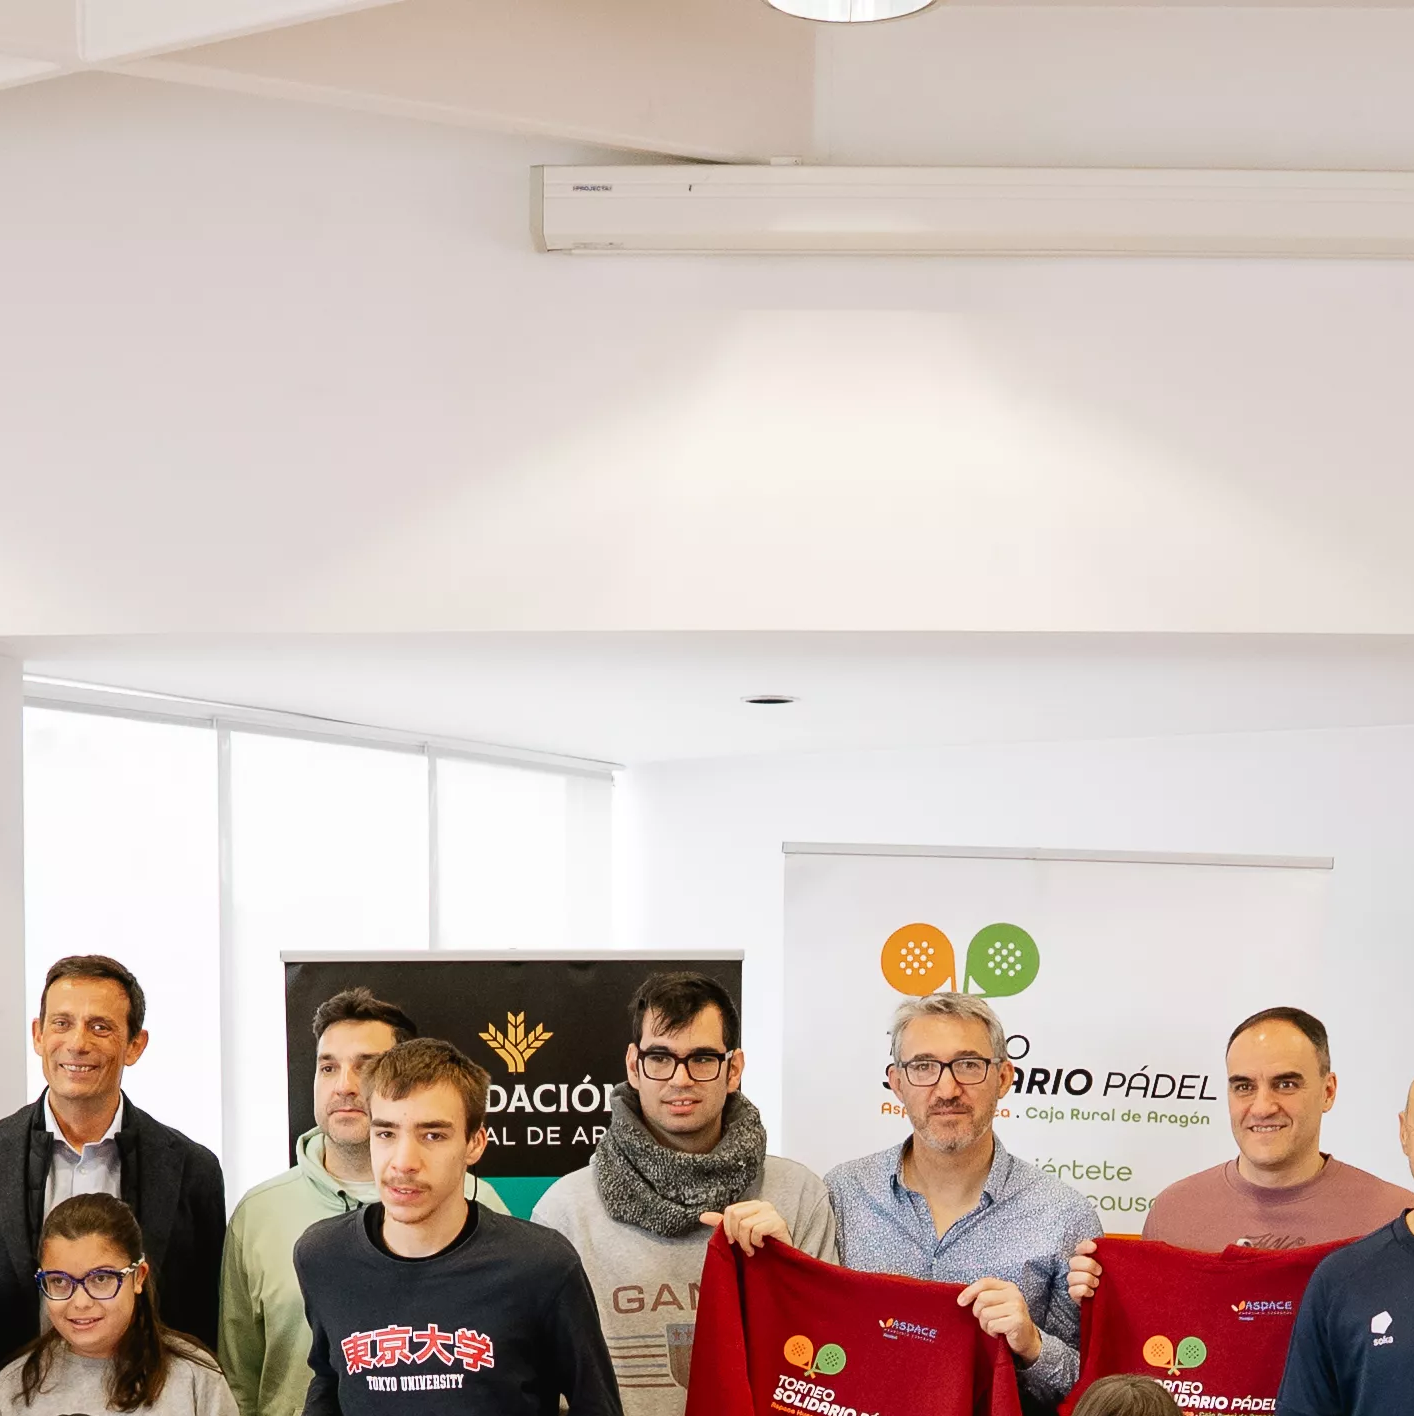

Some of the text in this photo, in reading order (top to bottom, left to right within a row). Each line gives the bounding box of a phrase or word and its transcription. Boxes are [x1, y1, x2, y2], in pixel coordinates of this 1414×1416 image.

[1102, 1065, 1218, 1101] PÁDEL
[1025, 1106, 1066, 1123] Caja
[1070, 1108, 1117, 1123] Rural
[1121, 1110, 1143, 1124] de
[1147, 1110, 1211, 1128] Aragón
[527, 1126, 562, 1146] DE
[1245, 1300, 1293, 1311] ASPACE
[891, 1319, 937, 1339] ASPACE
[341, 1323, 494, 1375] 東京大学
[366, 1374, 464, 1392] TOKYO UNIVERSITY
[778, 1374, 836, 1402] TORNEO
